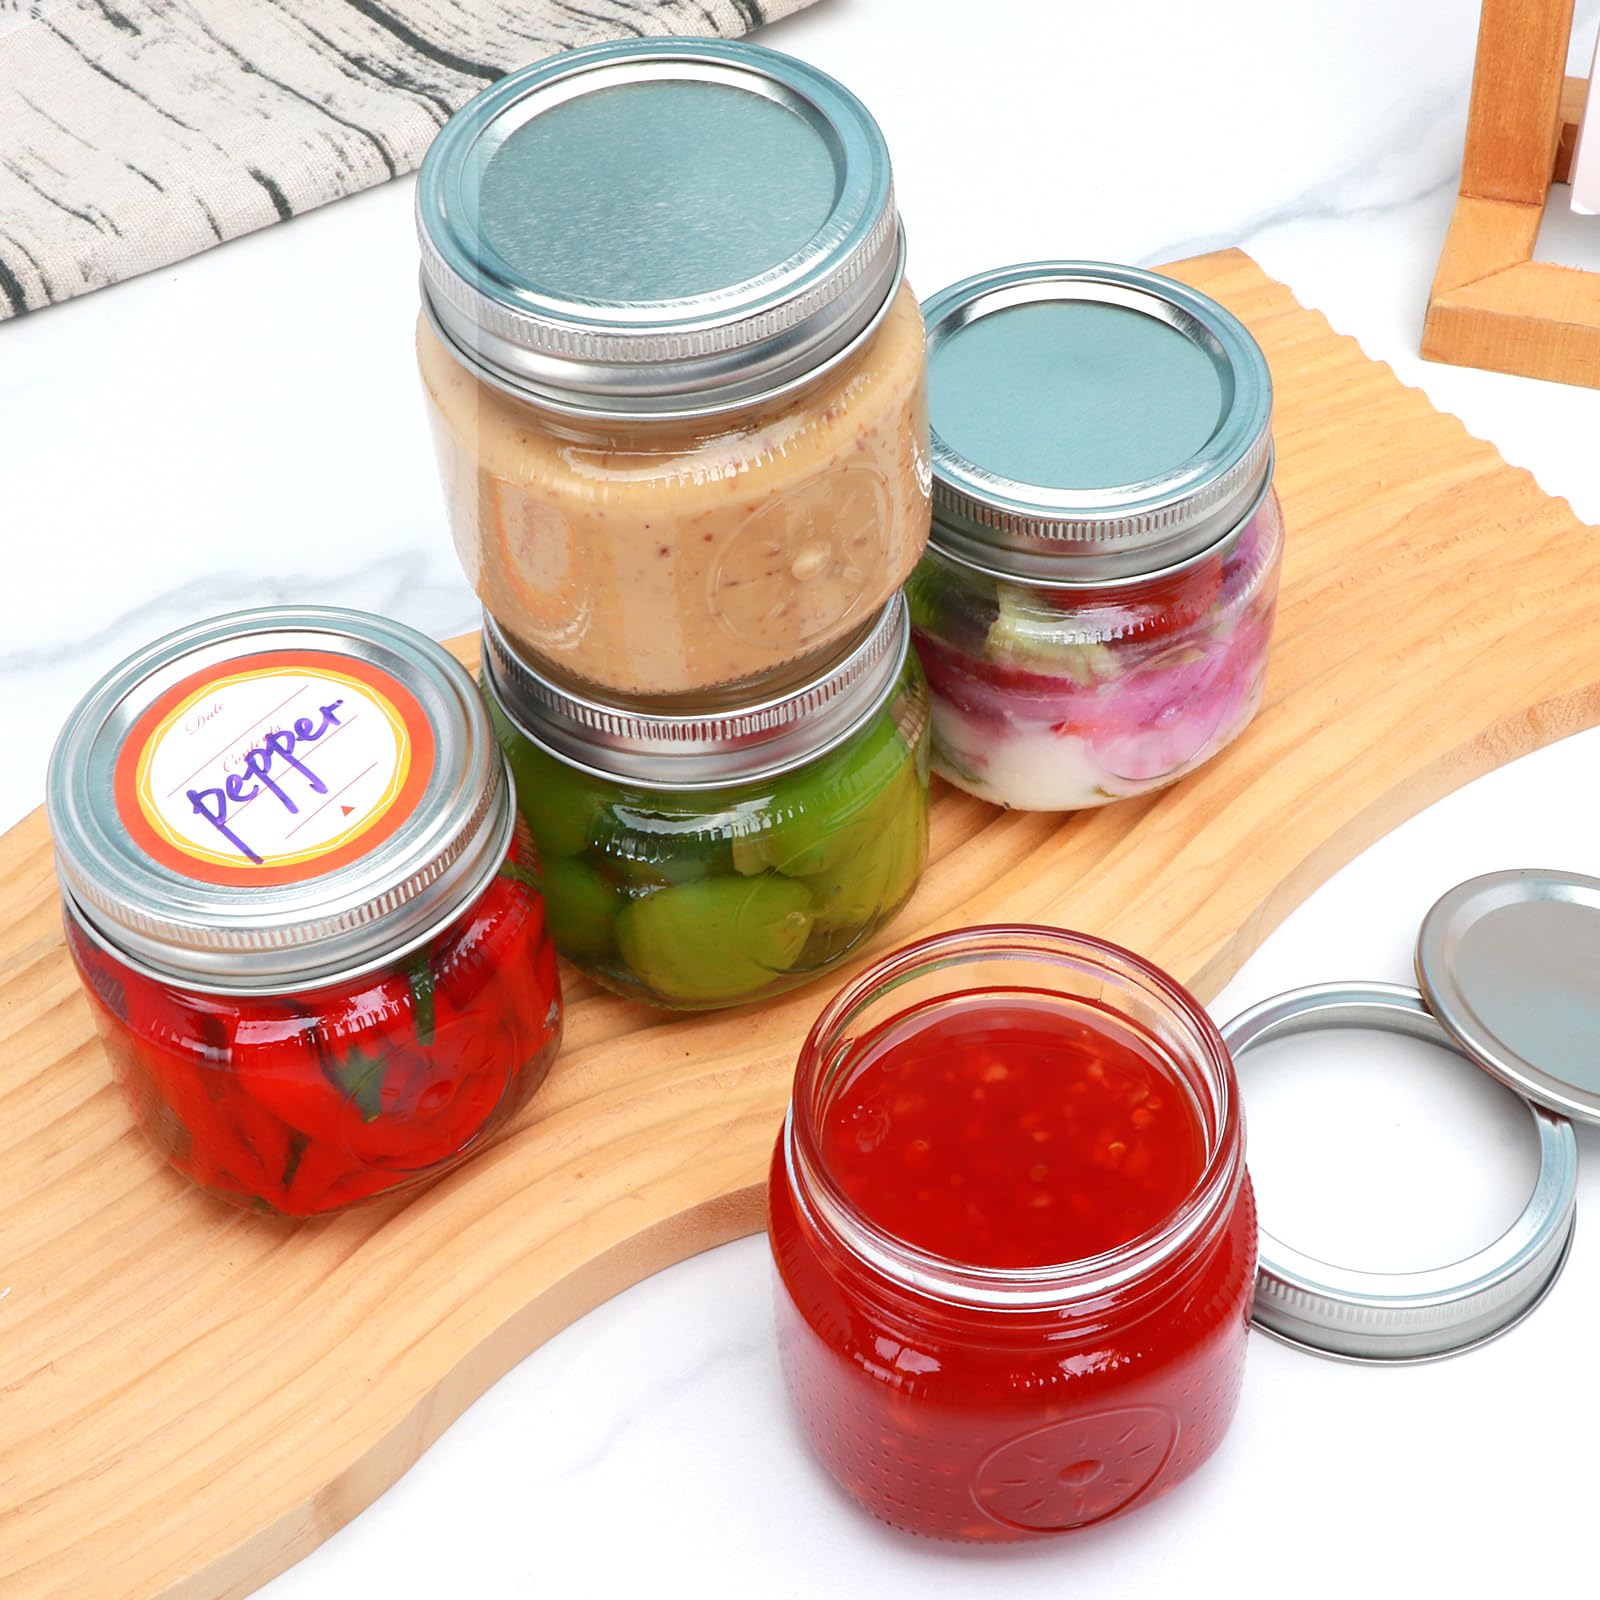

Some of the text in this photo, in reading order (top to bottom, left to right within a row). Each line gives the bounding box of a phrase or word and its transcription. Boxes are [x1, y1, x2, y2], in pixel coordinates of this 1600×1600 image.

[185, 703, 225, 735] Date
[223, 725, 282, 772] Contets
[186, 699, 343, 864] pepper
